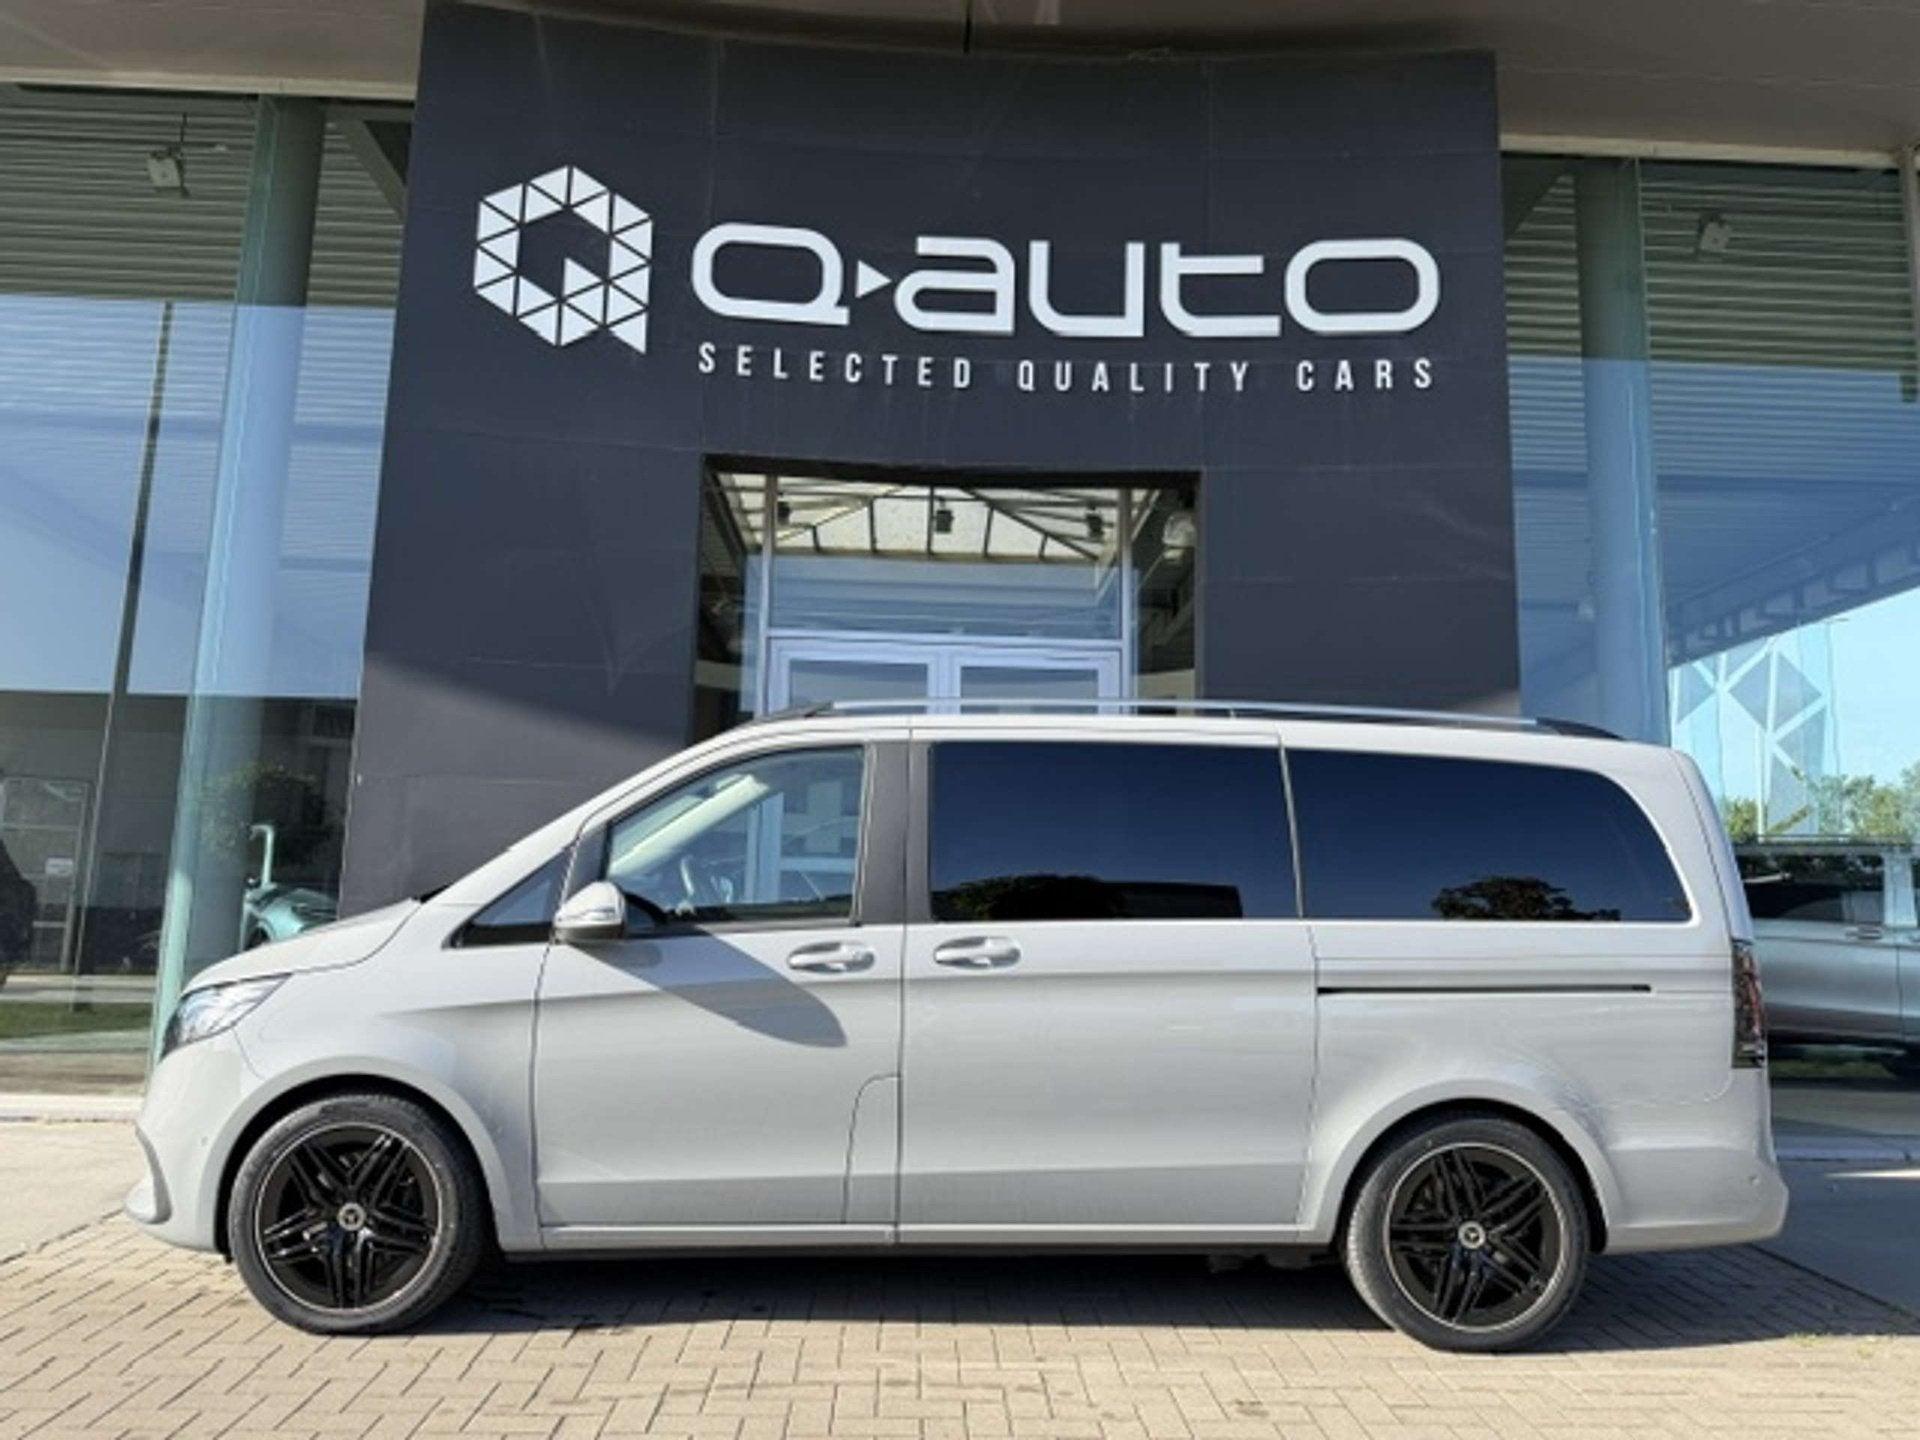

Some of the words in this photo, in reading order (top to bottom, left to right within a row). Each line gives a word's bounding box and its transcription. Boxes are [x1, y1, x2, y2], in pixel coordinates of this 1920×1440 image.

[697, 341, 971, 390] SELECTED
[1017, 359, 1249, 393] QUALITY
[1296, 357, 1433, 392] CARS
